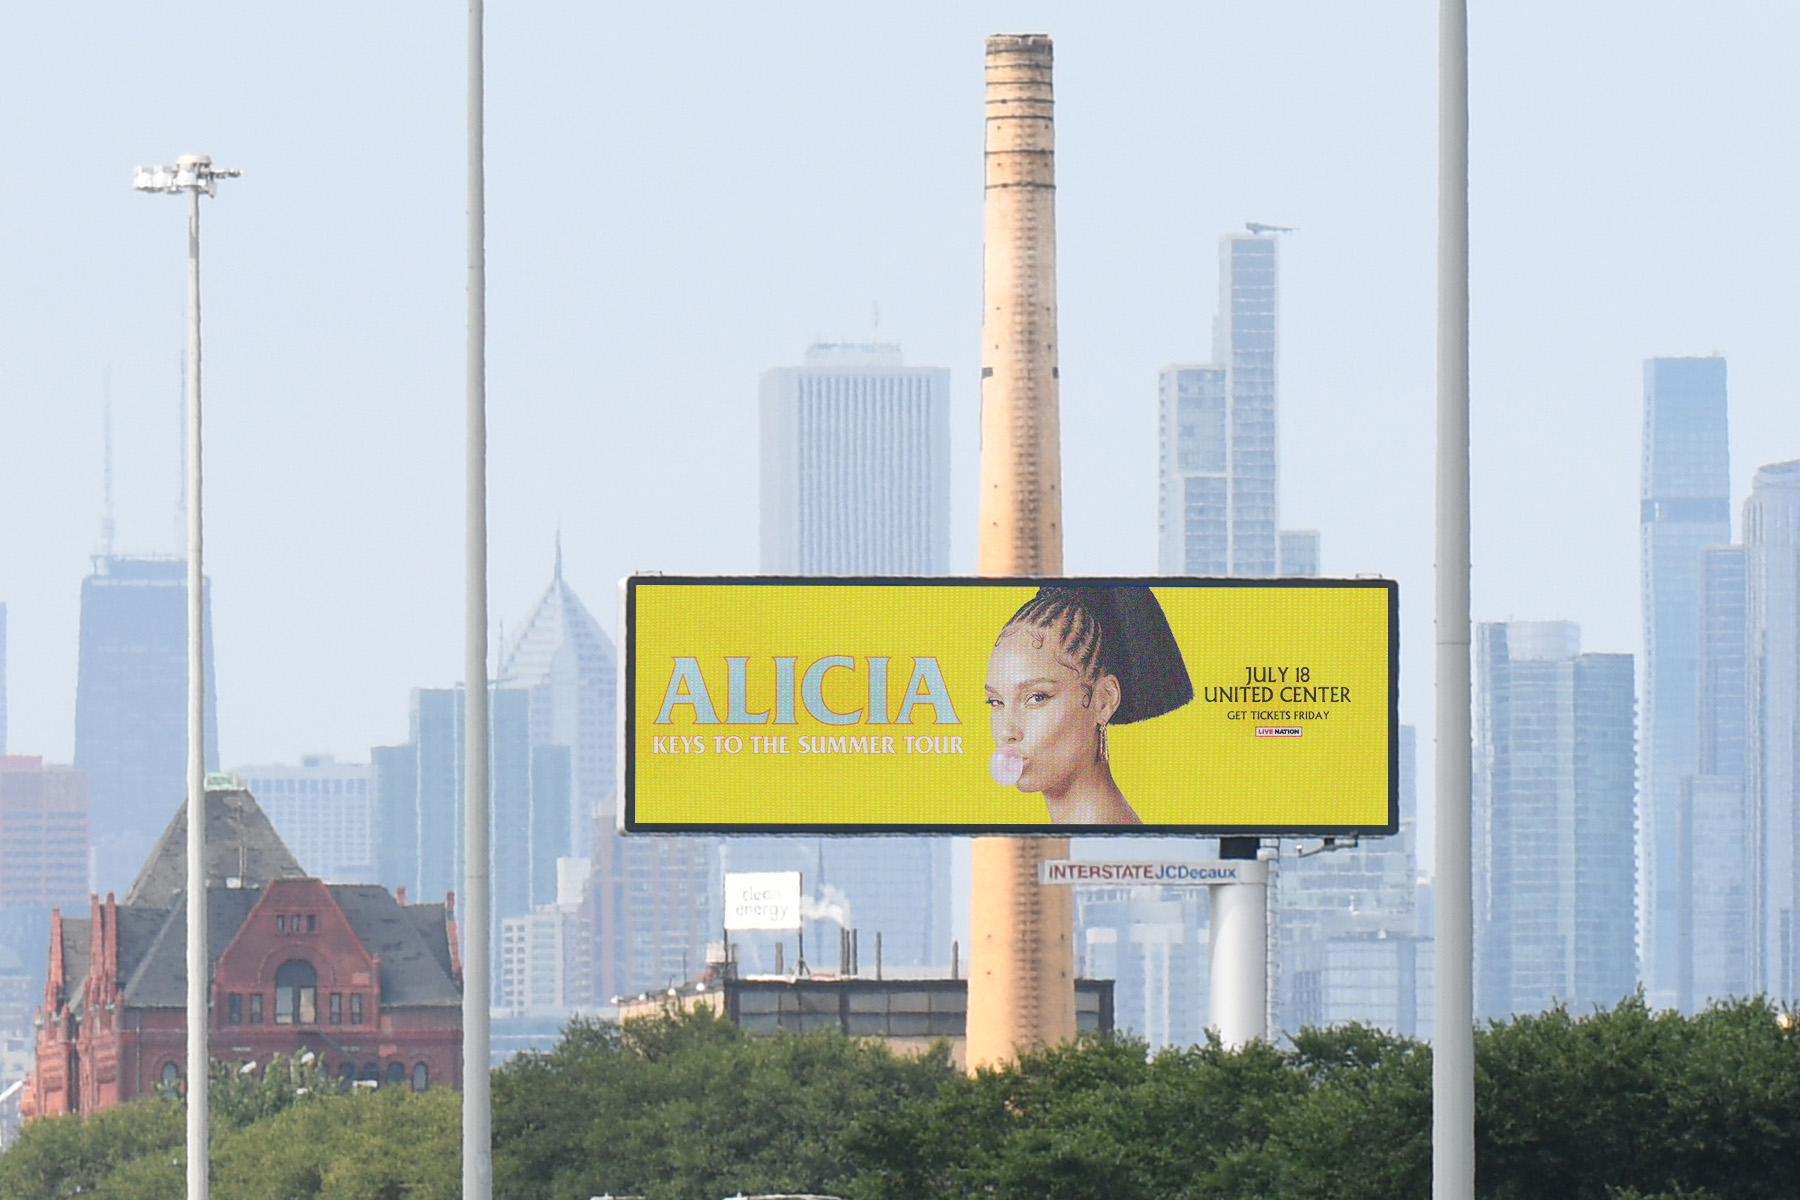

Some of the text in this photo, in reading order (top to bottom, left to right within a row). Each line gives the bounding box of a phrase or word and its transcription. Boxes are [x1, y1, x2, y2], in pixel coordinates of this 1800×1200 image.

[1246, 667, 1310, 685] JULY 18
[653, 655, 962, 725] ALICIA
[1205, 687, 1351, 702] UNITED CENTER
[1227, 711, 1329, 720] GET TICKETS FRIDAY
[653, 735, 964, 754] KEYS TO THE SUMMER TOUR
